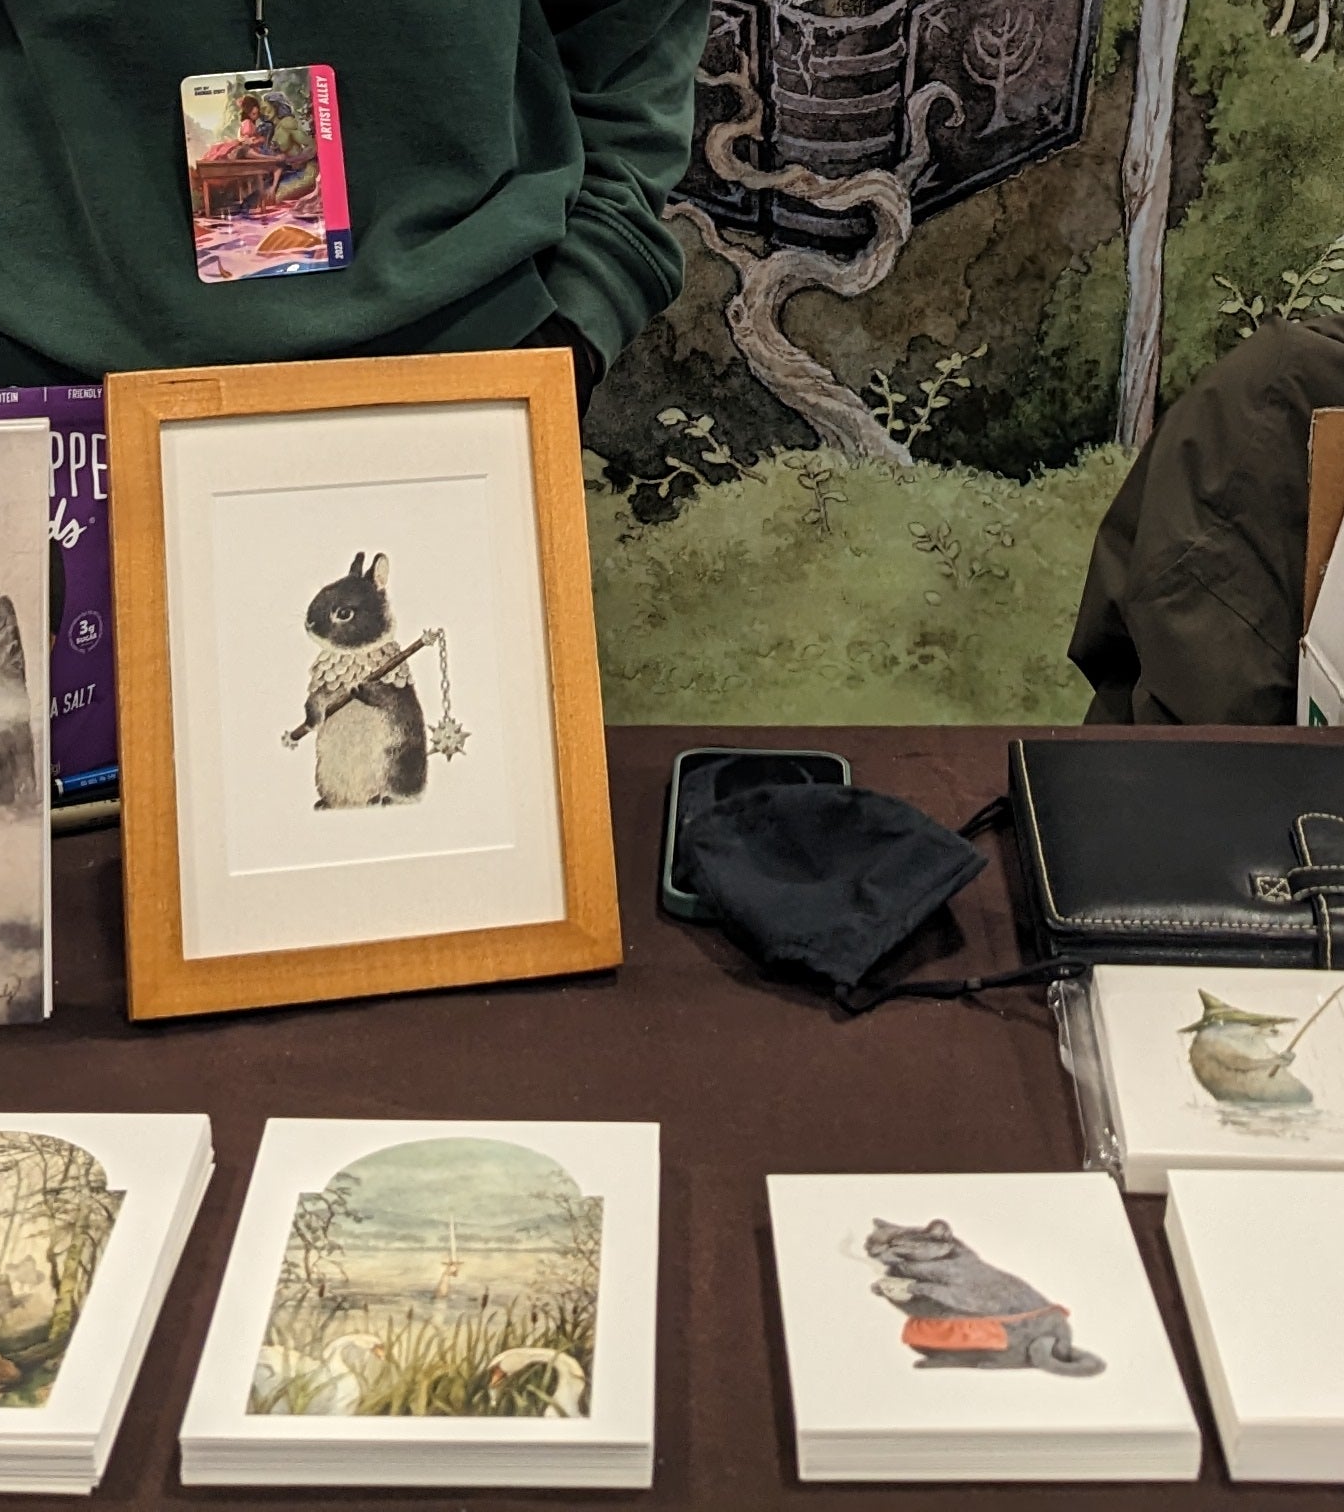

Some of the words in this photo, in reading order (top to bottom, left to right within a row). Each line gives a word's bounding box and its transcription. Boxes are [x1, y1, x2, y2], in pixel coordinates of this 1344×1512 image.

[316, 75, 330, 105] ALLEY
[318, 105, 333, 141] ARTIST
[67, 388, 103, 400] FRIENDLY
[49, 431, 108, 500] PPE
[79, 619, 96, 635] 3g
[50, 696, 59, 719] A
[63, 683, 96, 714] SALT
